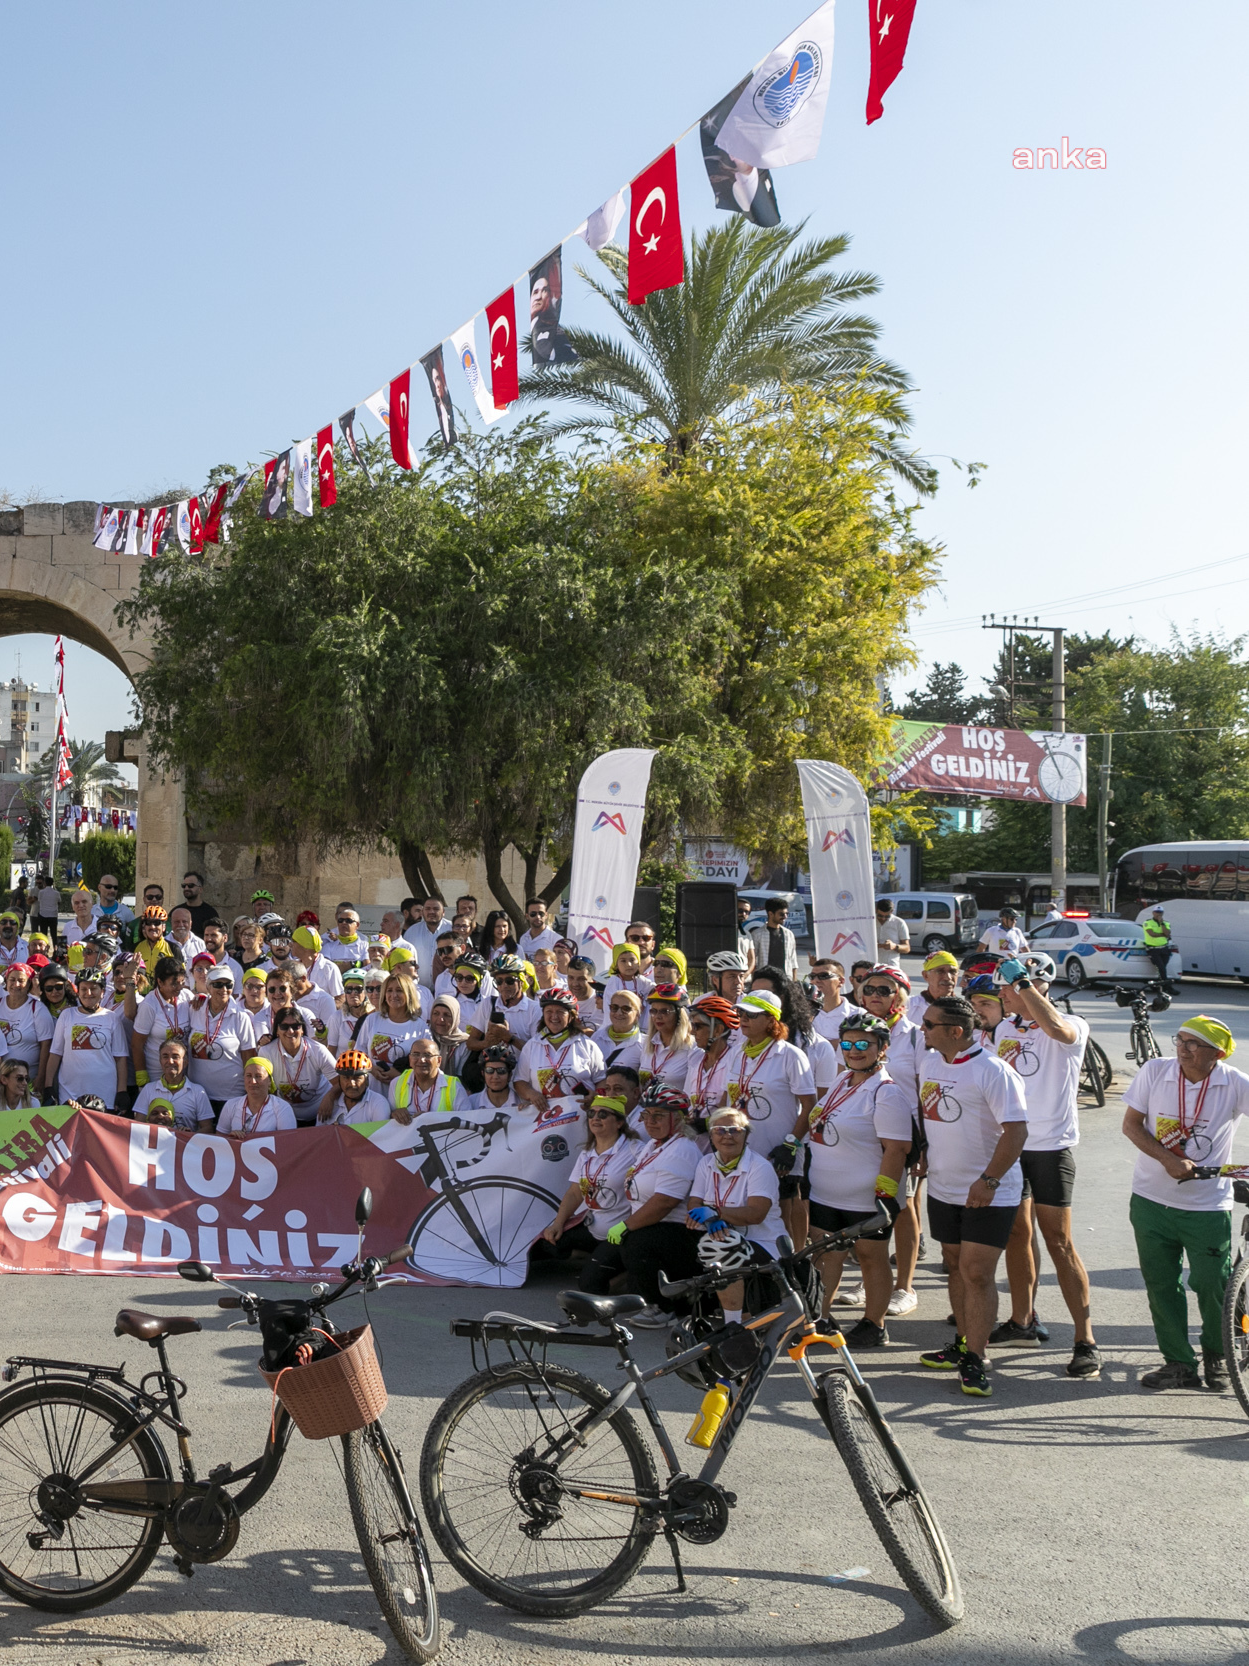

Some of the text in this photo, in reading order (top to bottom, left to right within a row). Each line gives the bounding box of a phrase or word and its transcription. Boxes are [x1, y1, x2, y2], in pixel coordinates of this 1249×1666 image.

[915, 730, 947, 761] Festivali
[962, 727, 1006, 757] HOŞ
[930, 751, 1031, 783] GELDİNİZ
[2, 1193, 366, 1268] GELDİNİZ
[718, 1345, 772, 1454] MOSSO
